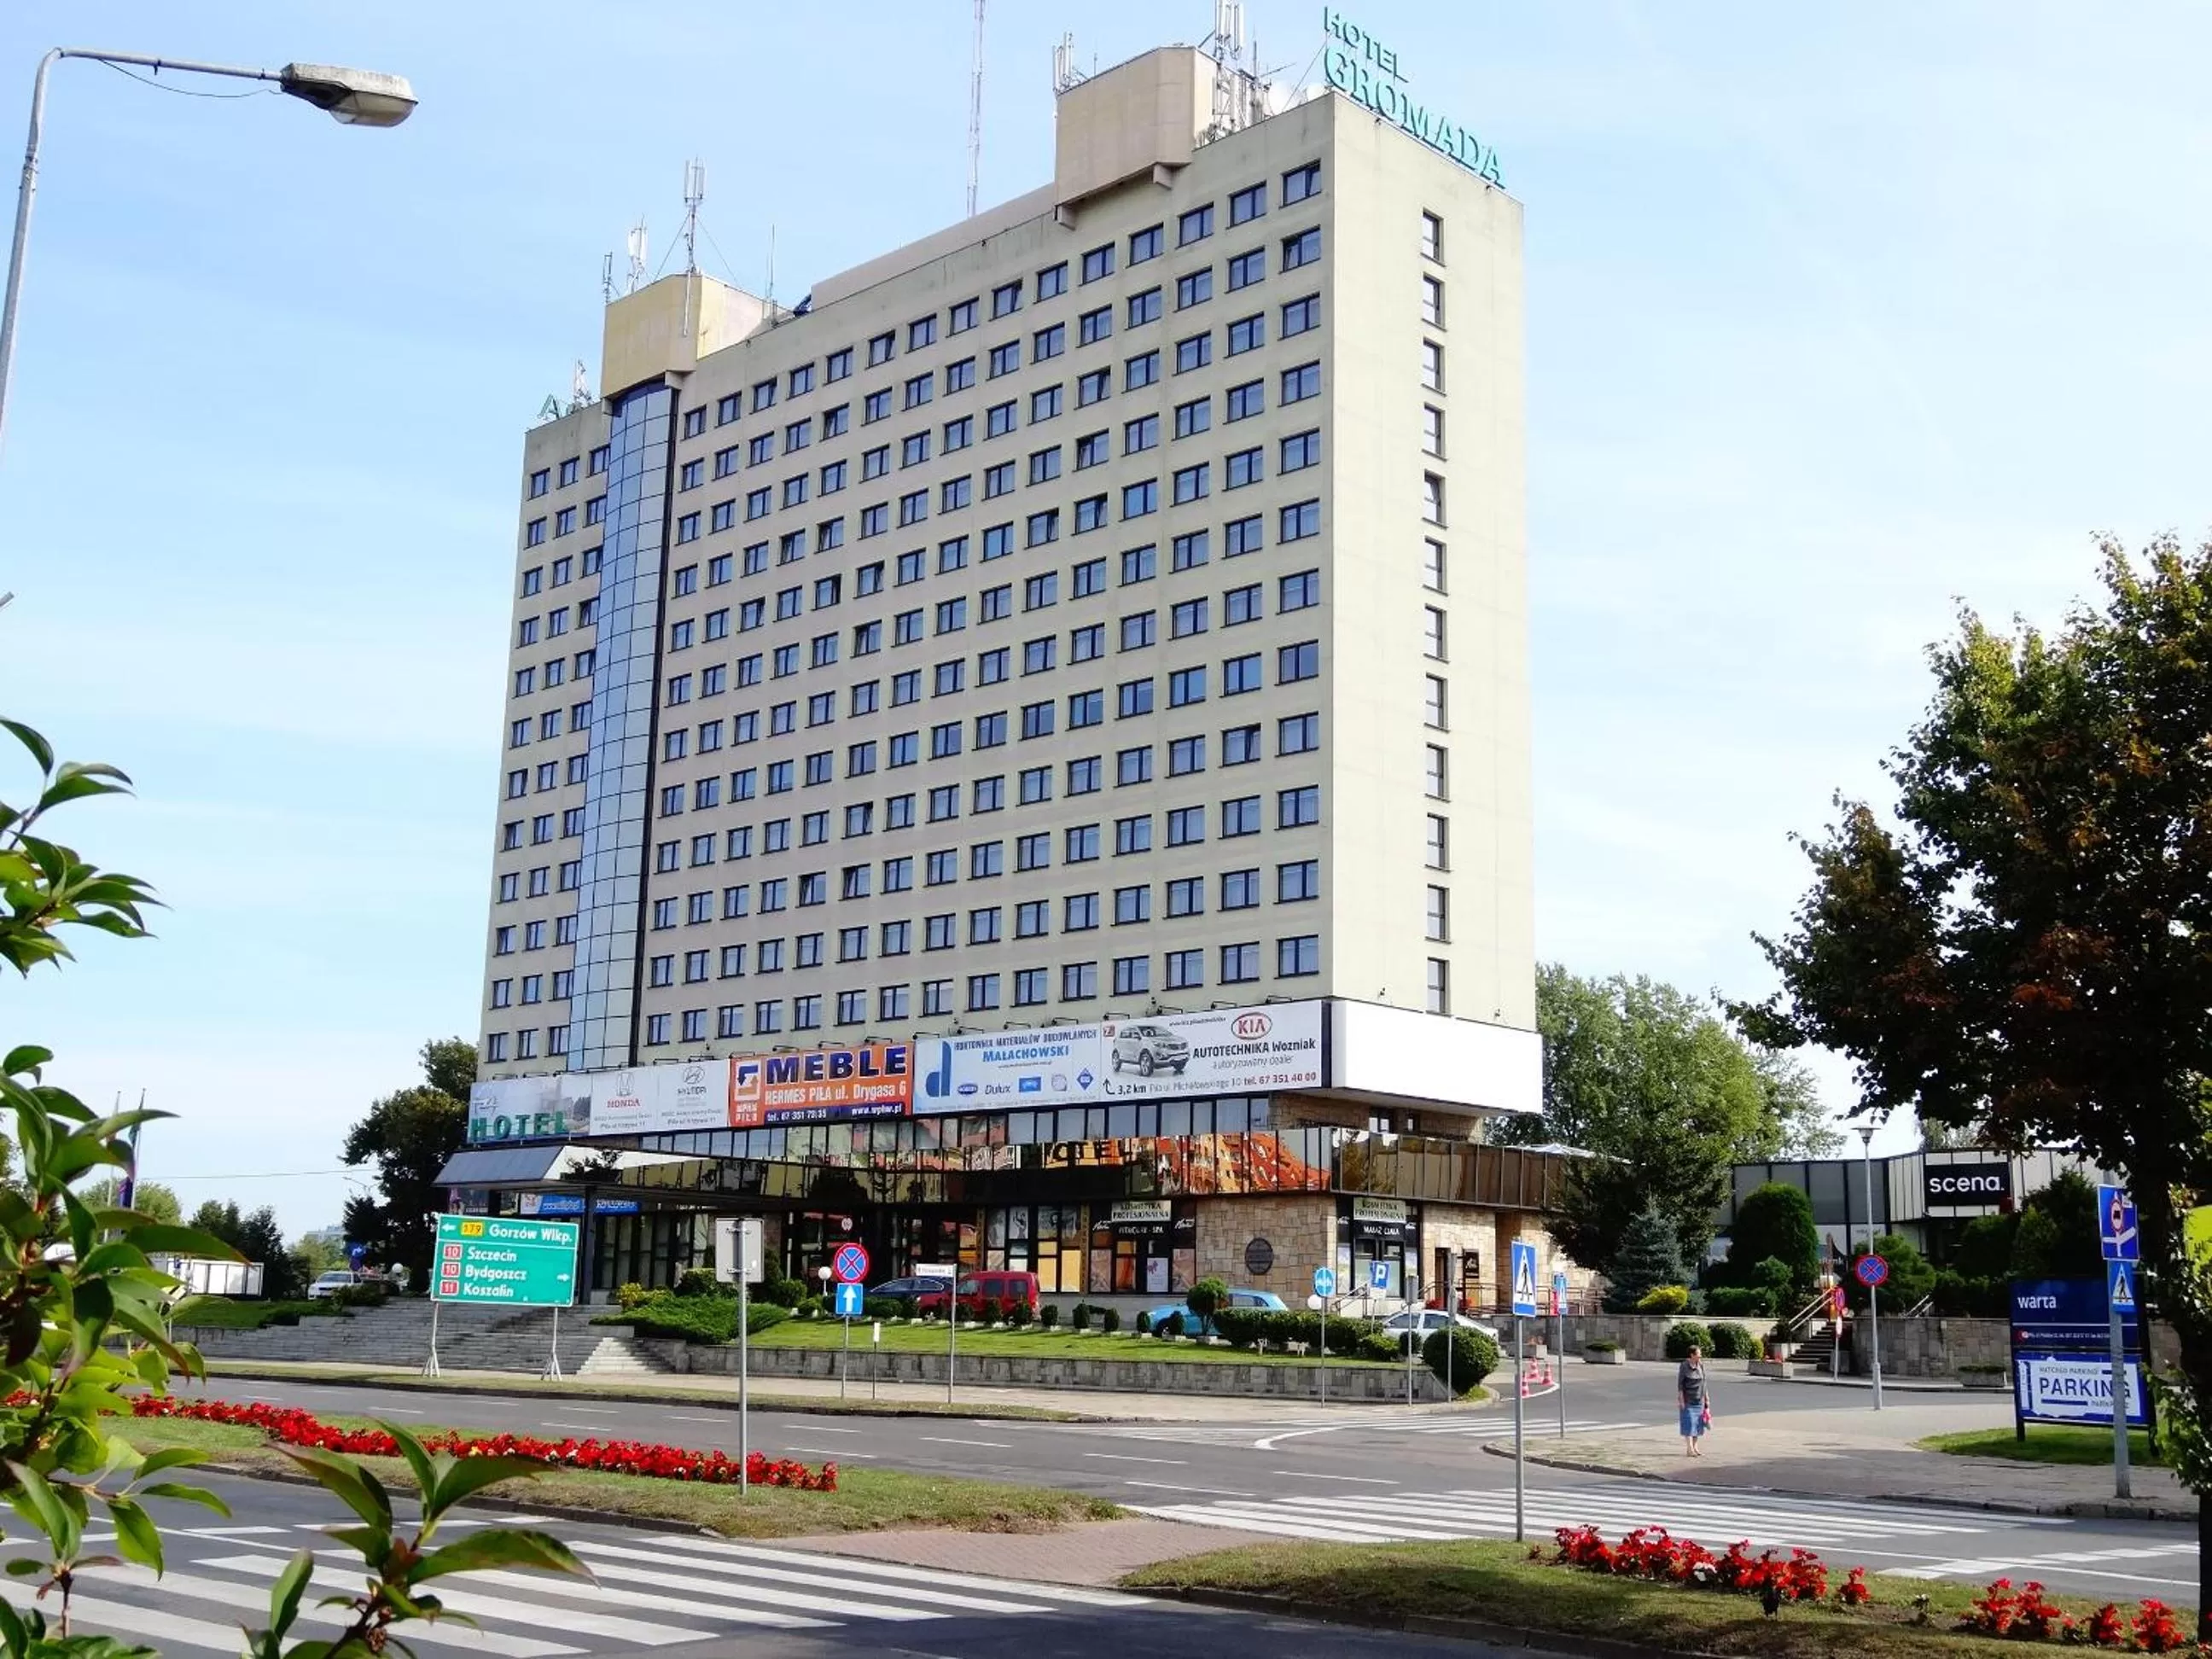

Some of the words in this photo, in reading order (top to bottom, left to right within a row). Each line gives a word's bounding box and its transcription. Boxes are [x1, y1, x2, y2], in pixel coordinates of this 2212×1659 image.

[1324, 6, 1408, 83] HOTEL
[1324, 47, 1506, 189] GROMADA
[1237, 1019, 1266, 1034] KIA
[983, 1045, 1069, 1062] MAŁACHOWSKI
[1193, 1042, 1269, 1059] AUTOTECHNIKA
[766, 1046, 906, 1085] MEBLE
[985, 1084, 1011, 1096] Dulux
[1118, 1085, 1132, 1096] 3,2
[1133, 1084, 1146, 1093] km
[1244, 1076, 1256, 1086] tel.
[1259, 1074, 1270, 1085] 67
[1272, 1074, 1289, 1083] 351
[1291, 1073, 1302, 1082] 40
[765, 1089, 806, 1106] HERMES
[809, 1086, 831, 1102] PIŁA
[835, 1085, 848, 1099] ul.
[853, 1083, 895, 1101] Drygasa
[899, 1080, 906, 1096] 6
[607, 1098, 640, 1108] HONDA
[792, 1111, 805, 1120] 351
[471, 1111, 566, 1141] HOTEL
[1930, 1176, 2005, 1192] scena.
[489, 1224, 537, 1239] Gorzów
[541, 1228, 572, 1245] Wlkp.
[446, 1249, 458, 1258] 10
[467, 1246, 517, 1262] Szczecin
[445, 1266, 457, 1275] 10
[464, 1265, 527, 1281] Bydgoszcz
[463, 1283, 514, 1297] Koszalin
[2017, 1295, 2057, 1309] warta
